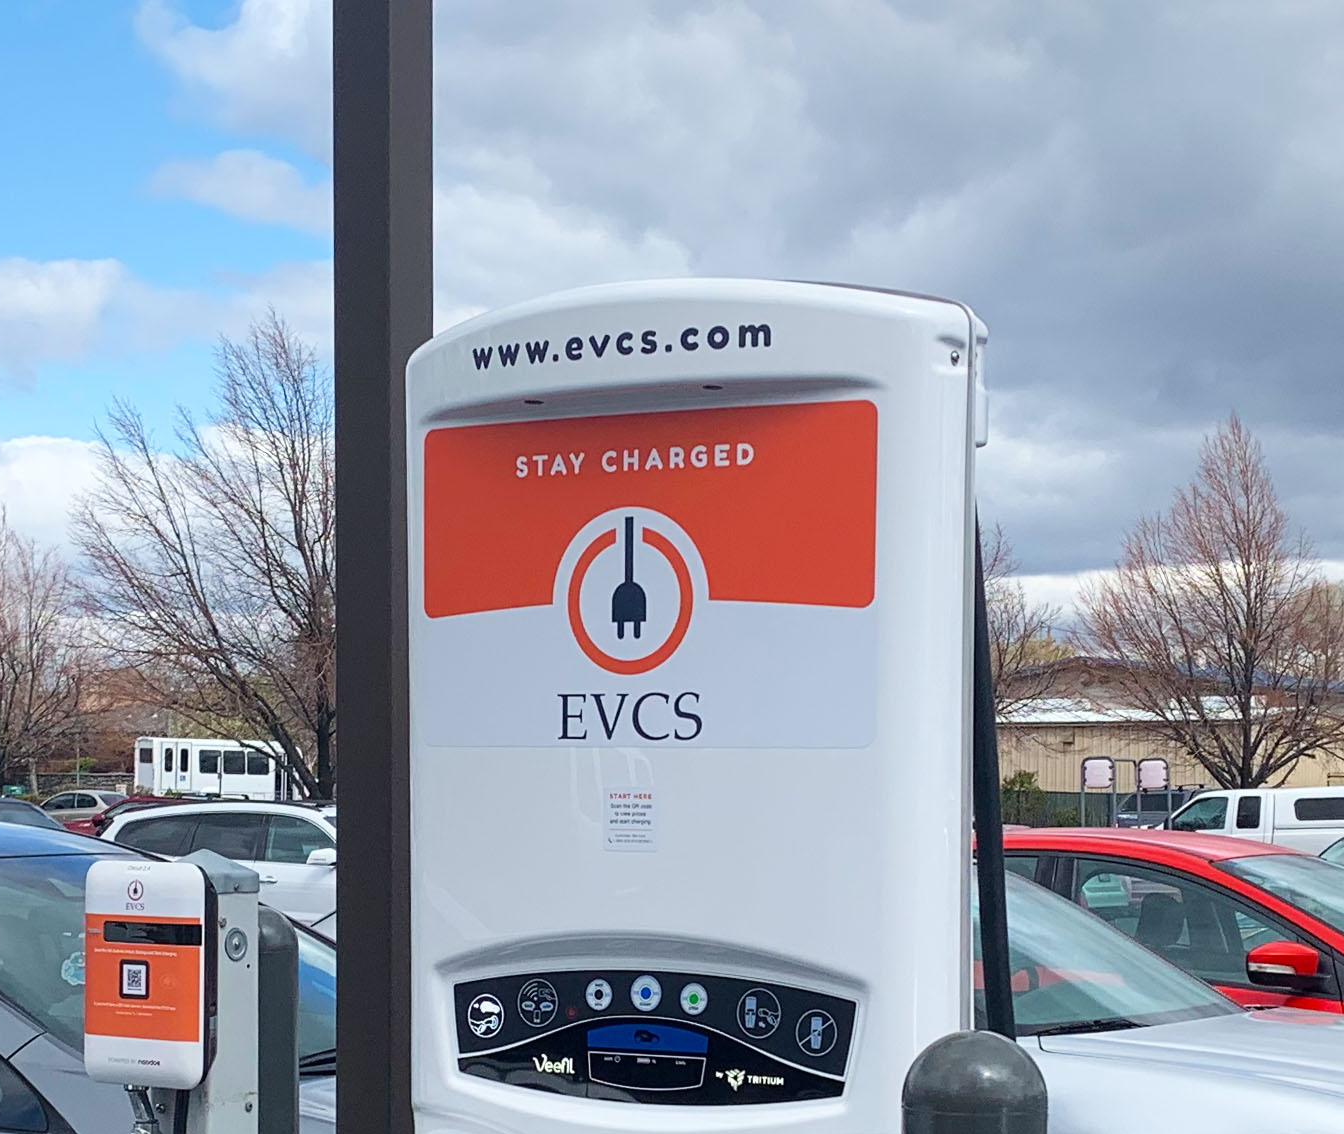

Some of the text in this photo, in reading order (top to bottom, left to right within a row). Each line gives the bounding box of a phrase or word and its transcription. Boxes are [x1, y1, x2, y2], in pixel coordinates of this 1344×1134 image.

[472, 323, 772, 371] www.evcs.com
[515, 442, 755, 478] STAY CHARGED
[556, 691, 703, 741] EVCS
[125, 902, 145, 911] EVCS
[746, 1074, 785, 1086] TRITIUM
